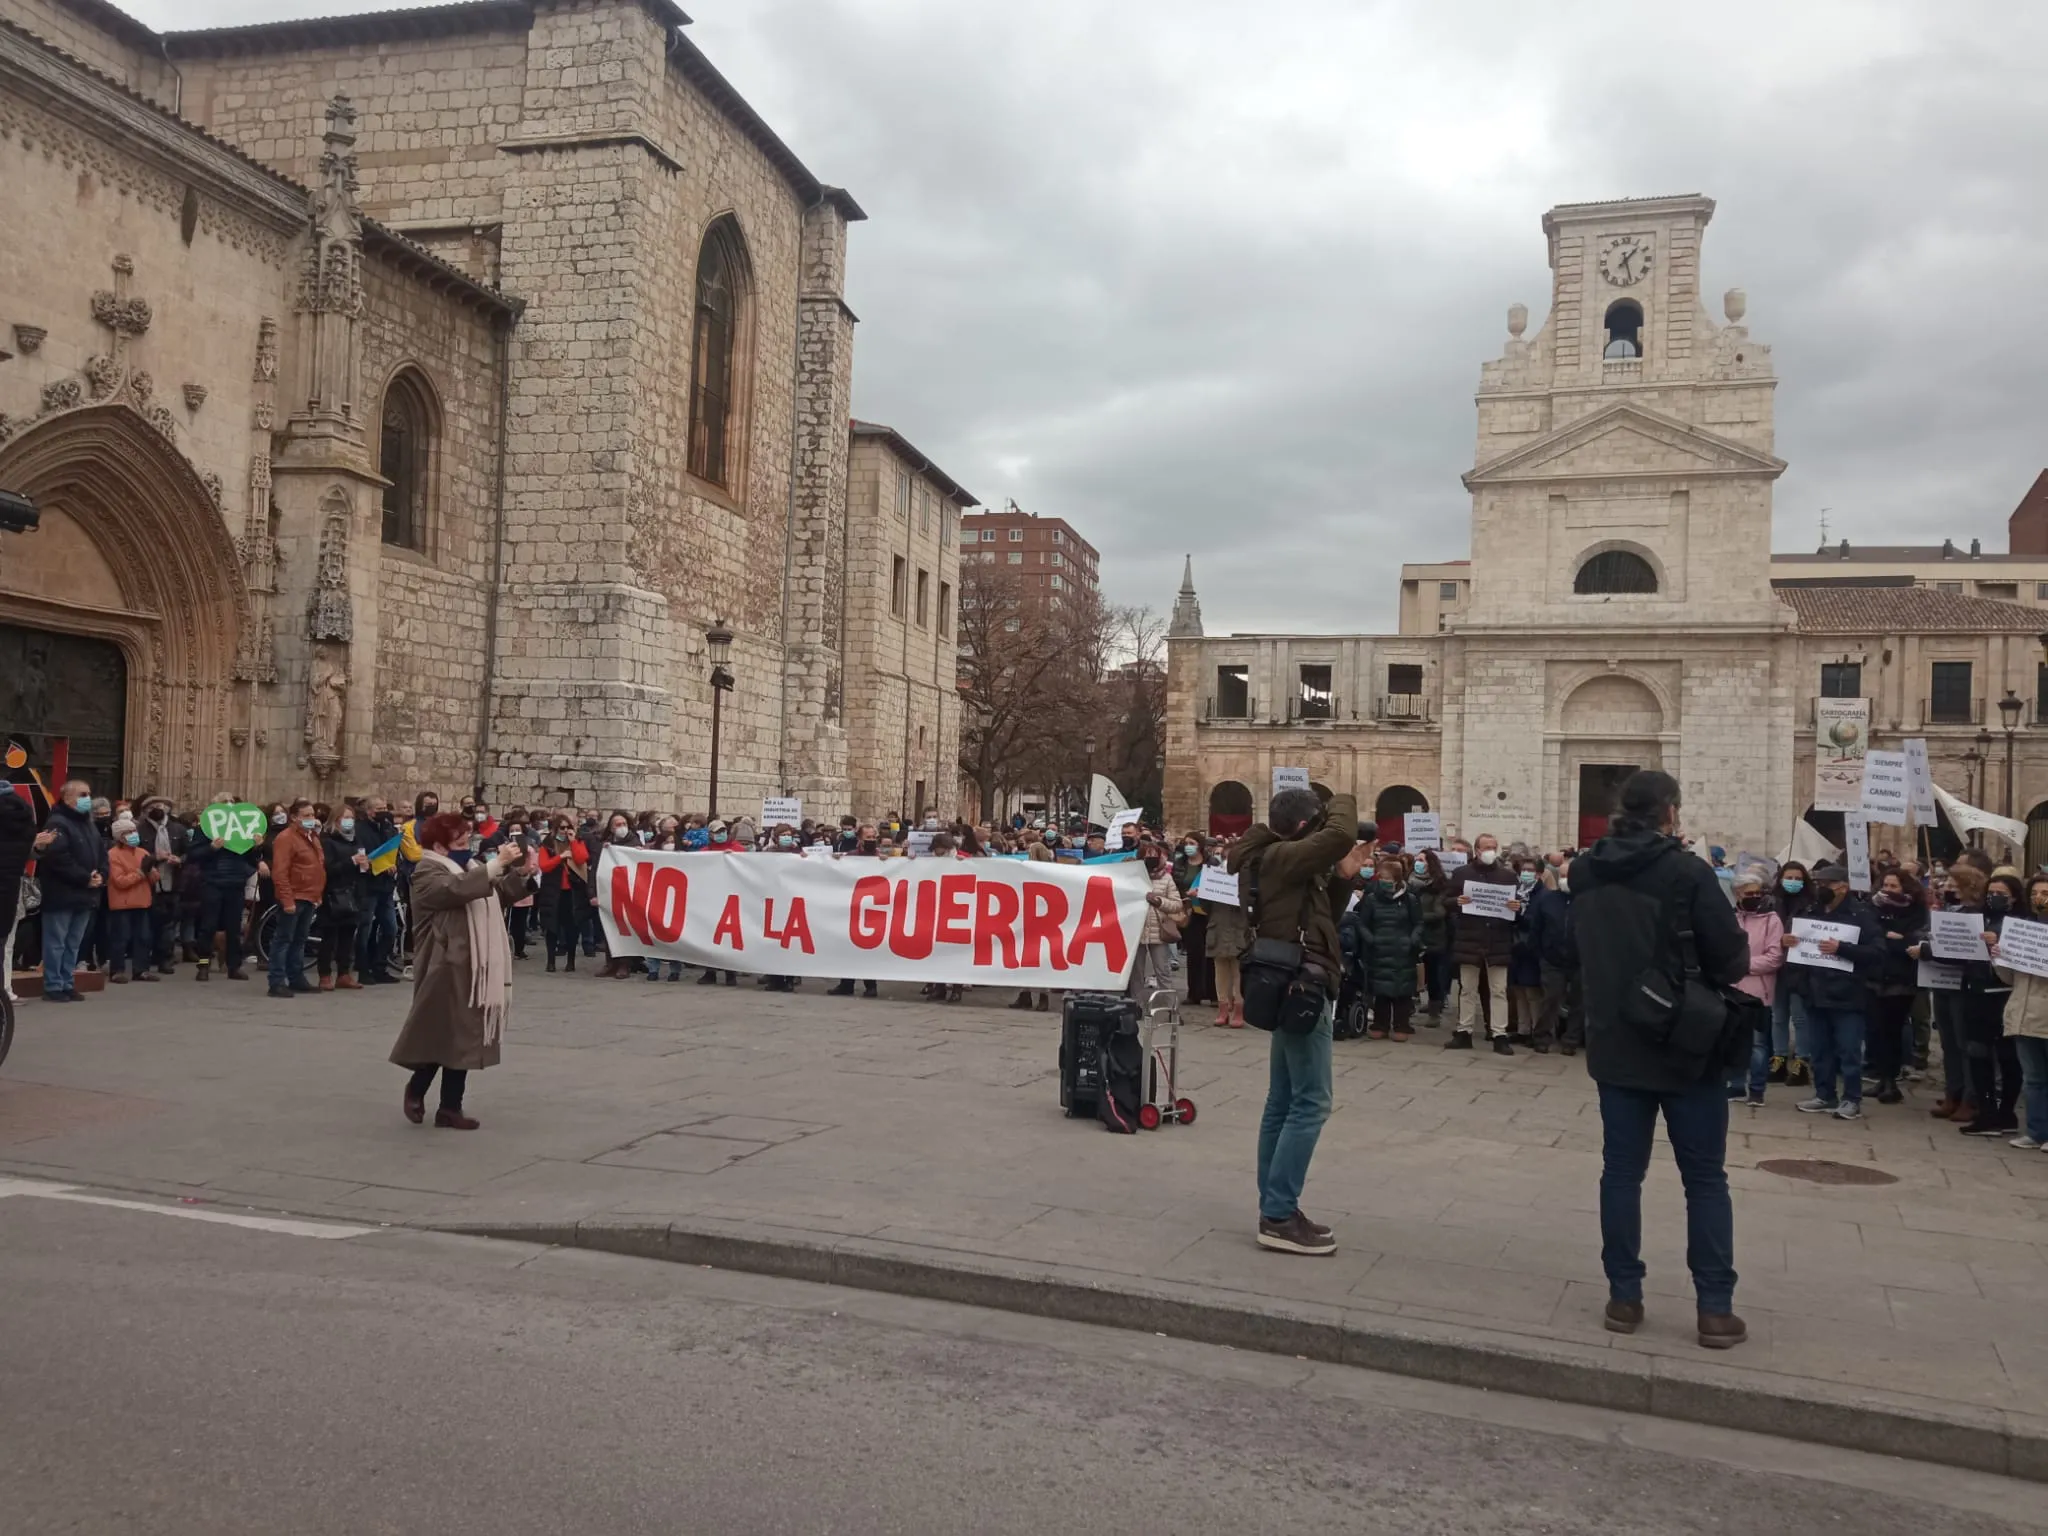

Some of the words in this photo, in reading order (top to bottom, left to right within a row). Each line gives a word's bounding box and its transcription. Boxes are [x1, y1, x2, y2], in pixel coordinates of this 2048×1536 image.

[1874, 760, 1903, 768] SIEMPRE
[1869, 788, 1902, 798] CAMINO
[207, 809, 261, 841] PAZ
[611, 862, 688, 946] NO
[713, 895, 744, 950] A
[763, 896, 815, 955] LA
[849, 874, 1128, 974] GUERRA
